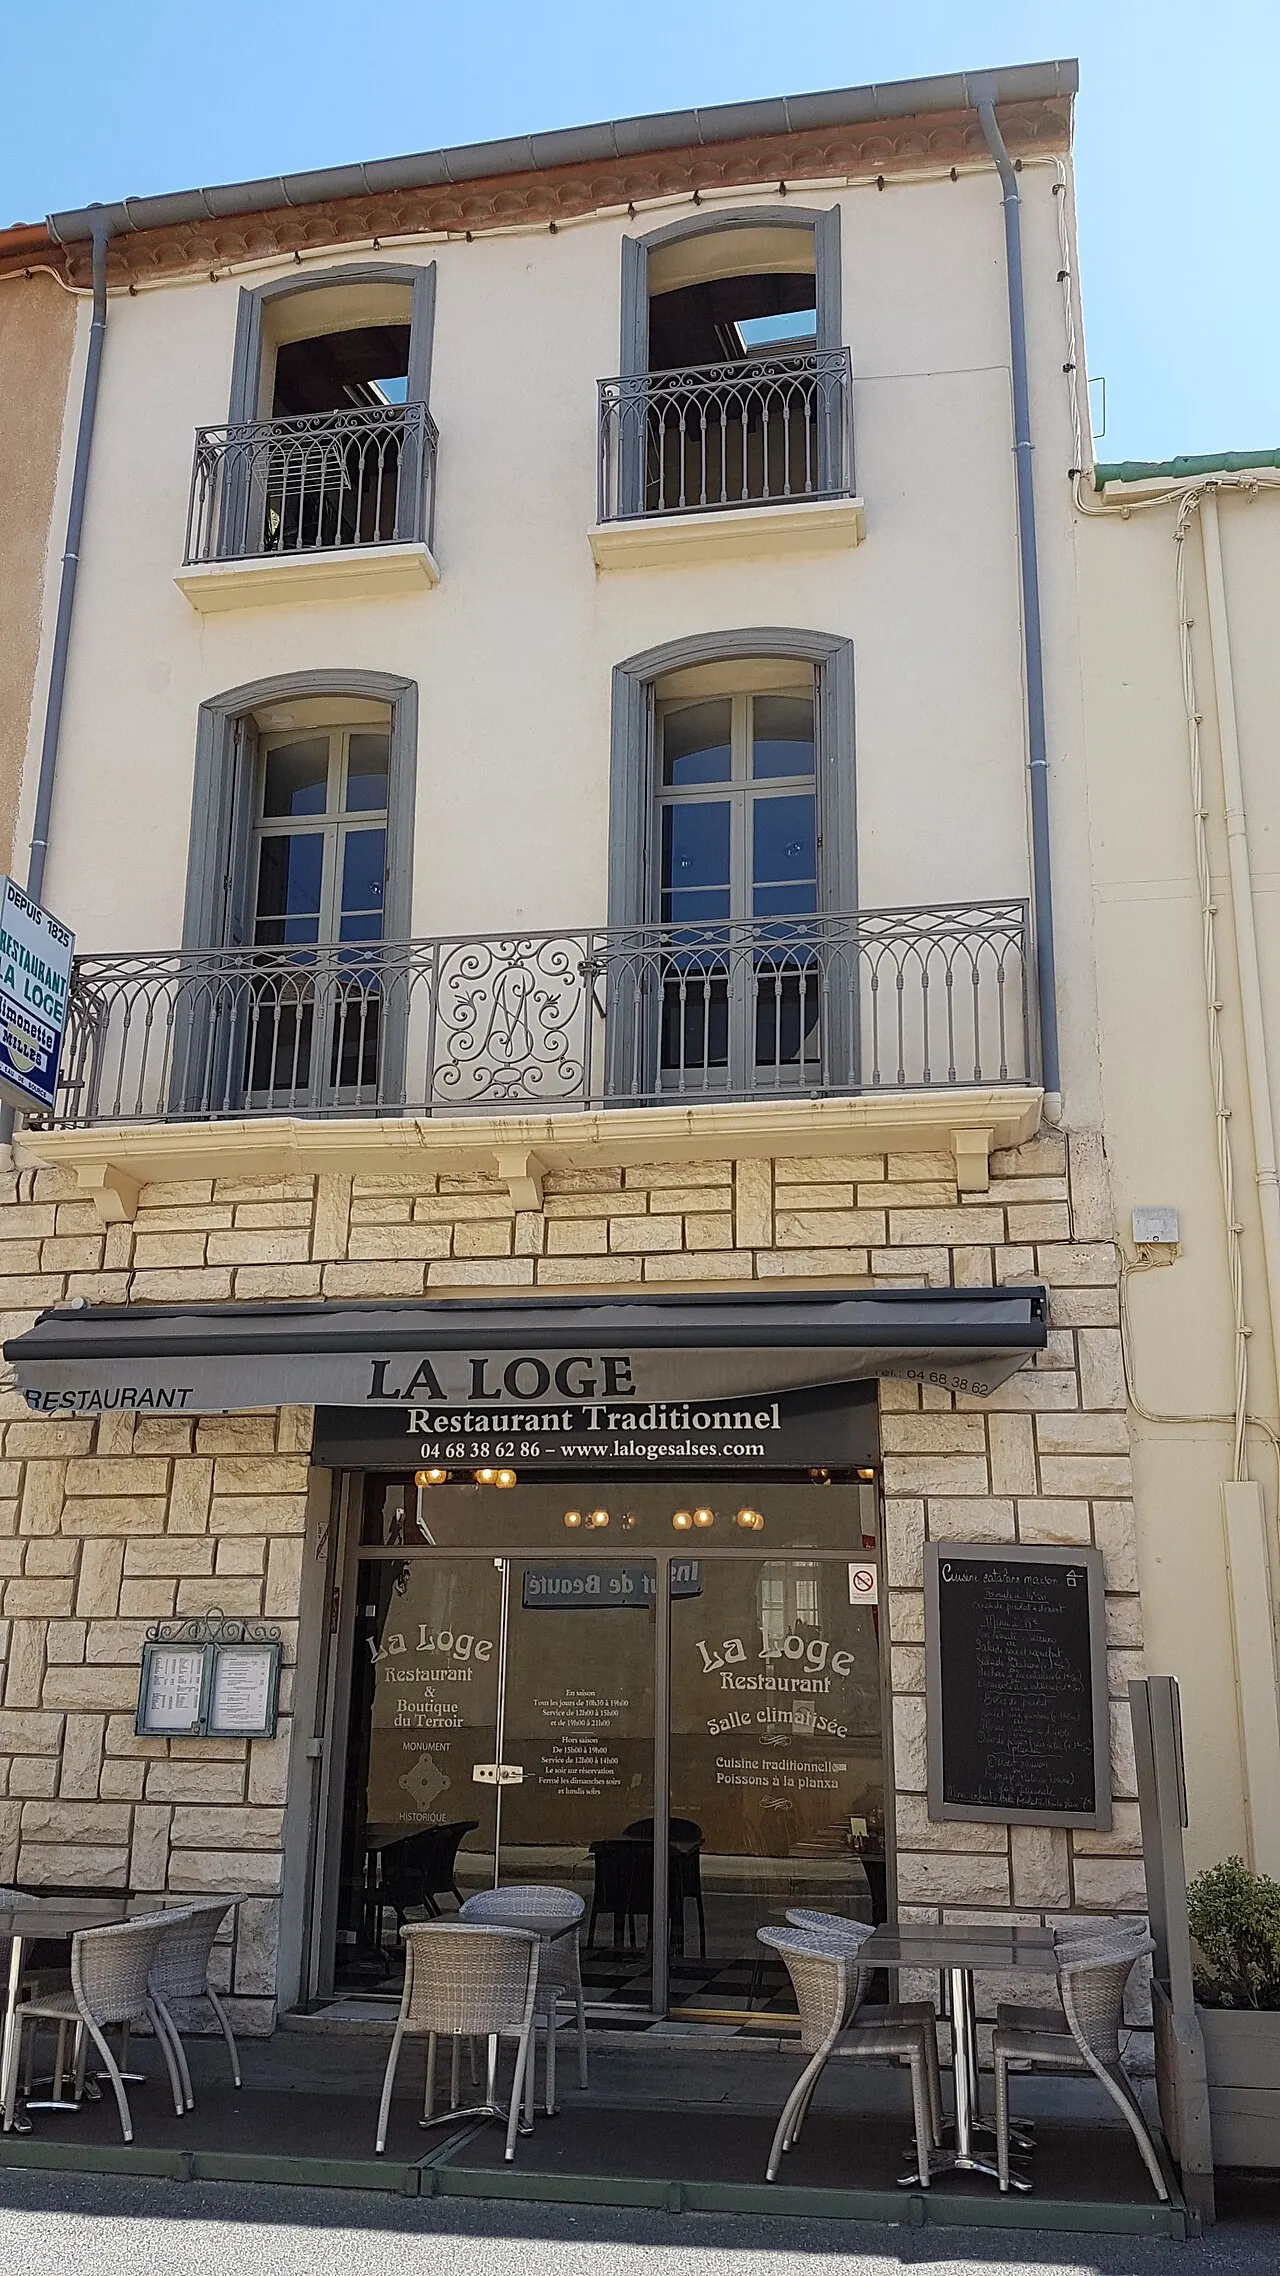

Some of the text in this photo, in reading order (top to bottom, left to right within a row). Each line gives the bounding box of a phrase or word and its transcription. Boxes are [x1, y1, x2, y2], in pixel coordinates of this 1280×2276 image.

[8, 885, 70, 948] DEPUIS 1825
[0, 927, 66, 997] RESTAURANT
[0, 956, 63, 1024] A LOGE
[3, 1029, 42, 1067] MILLES
[367, 1356, 637, 1400] LA LOGE
[907, 1370, 925, 1380] 04
[929, 1372, 947, 1384] 68
[951, 1376, 969, 1390] 38
[971, 1383, 989, 1396] 62
[25, 1388, 194, 1409] RESTAURANT
[406, 1404, 782, 1433] Restaurant Traditionnel
[420, 1443, 440, 1458] 04
[445, 1443, 467, 1458] 68
[470, 1442, 491, 1458] 38
[495, 1442, 515, 1458] 62
[519, 1442, 541, 1458] 86
[560, 1440, 765, 1460] www.lalogesalses.com
[366, 1624, 493, 1663] La Loge
[696, 1626, 855, 1676] La Loge
[384, 1667, 473, 1682] Restaurant
[720, 1671, 831, 1693] Restaurant
[424, 1685, 436, 1698] &
[397, 1699, 458, 1716] Boutique
[559, 1699, 575, 1707] jours
[393, 1713, 464, 1728] du Terroir
[707, 1707, 848, 1738] Salle climatisée
[402, 1742, 451, 1752] MONUMENT
[541, 1756, 565, 1764] Service
[716, 1757, 840, 1772] Cuisine traditionnelle
[560, 1776, 569, 1784] les
[570, 1776, 605, 1785] dimanches
[716, 1772, 839, 1790] Poissons à la planxa
[399, 1812, 447, 1823] HISTORIQUE
